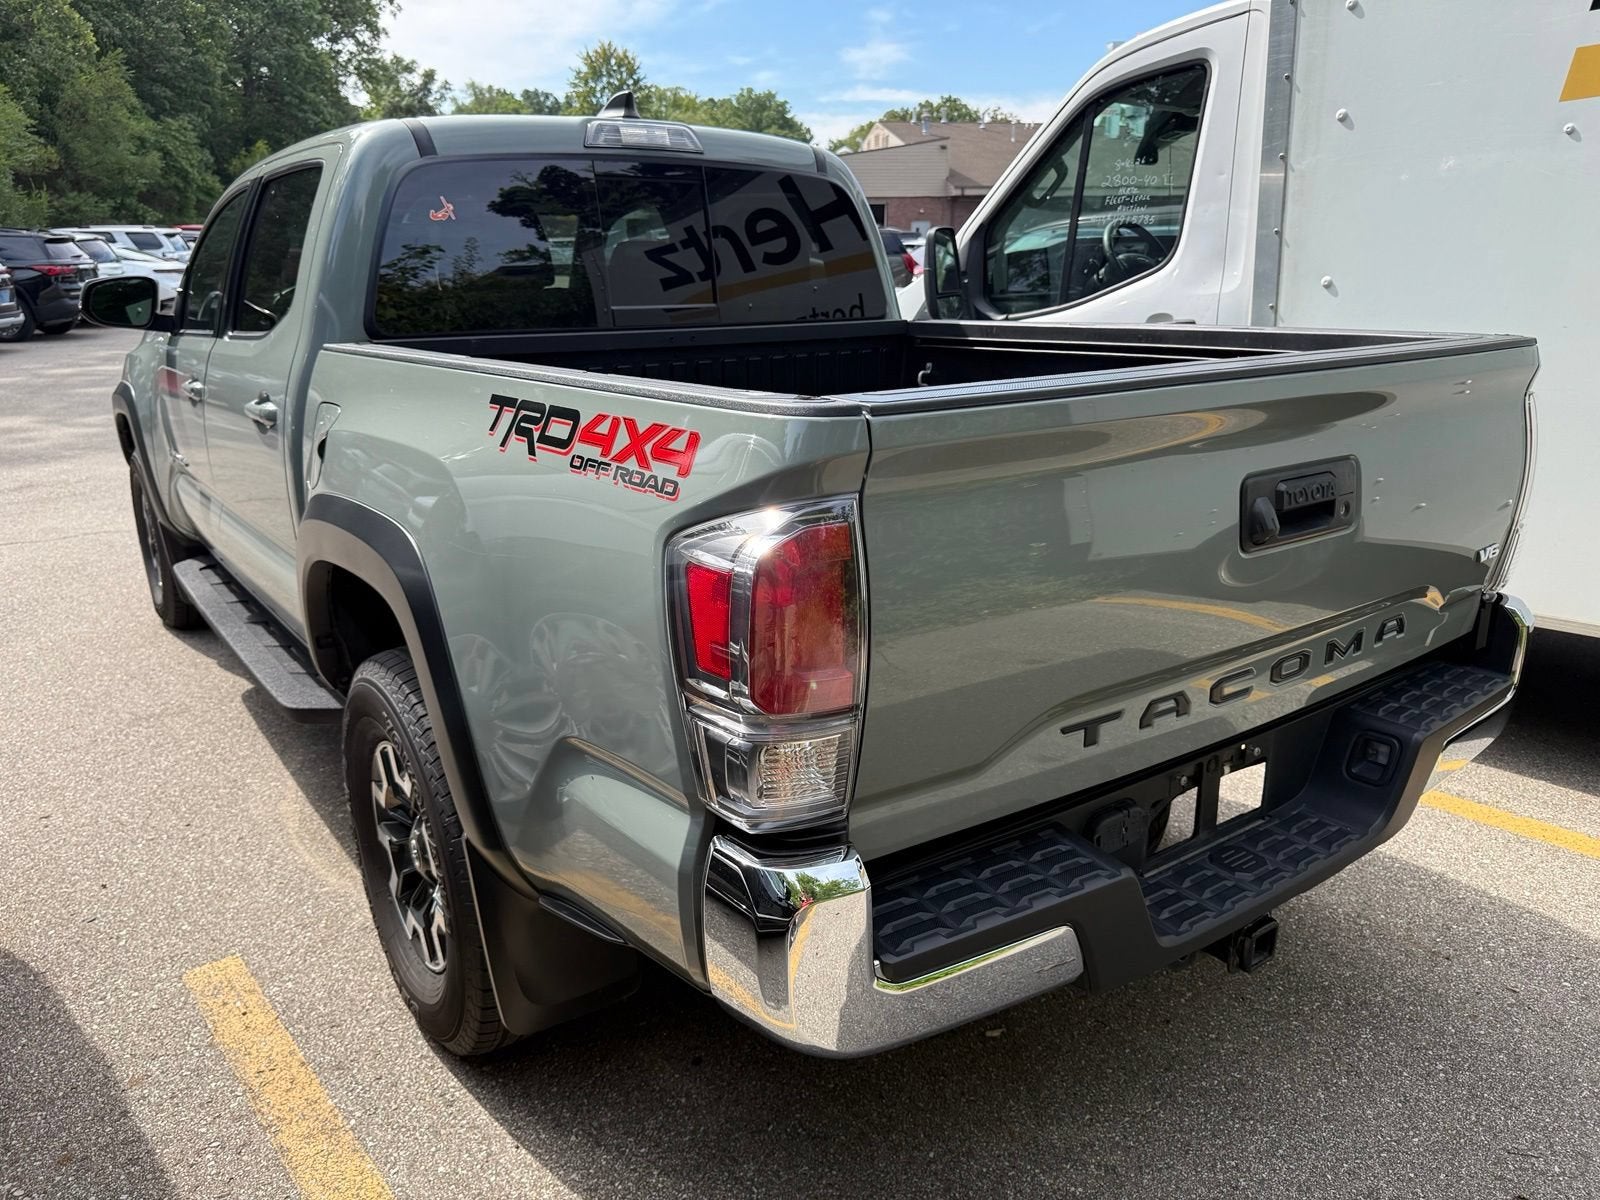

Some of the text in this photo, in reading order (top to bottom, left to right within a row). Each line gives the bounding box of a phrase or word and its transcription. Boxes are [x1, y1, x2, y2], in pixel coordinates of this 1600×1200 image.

[489, 393, 581, 463] TRD
[569, 454, 680, 502] OFF ROAD
[1285, 481, 1336, 506] TOYOTA
[1479, 543, 1500, 563] V6
[1059, 612, 1406, 749] TACOMA
